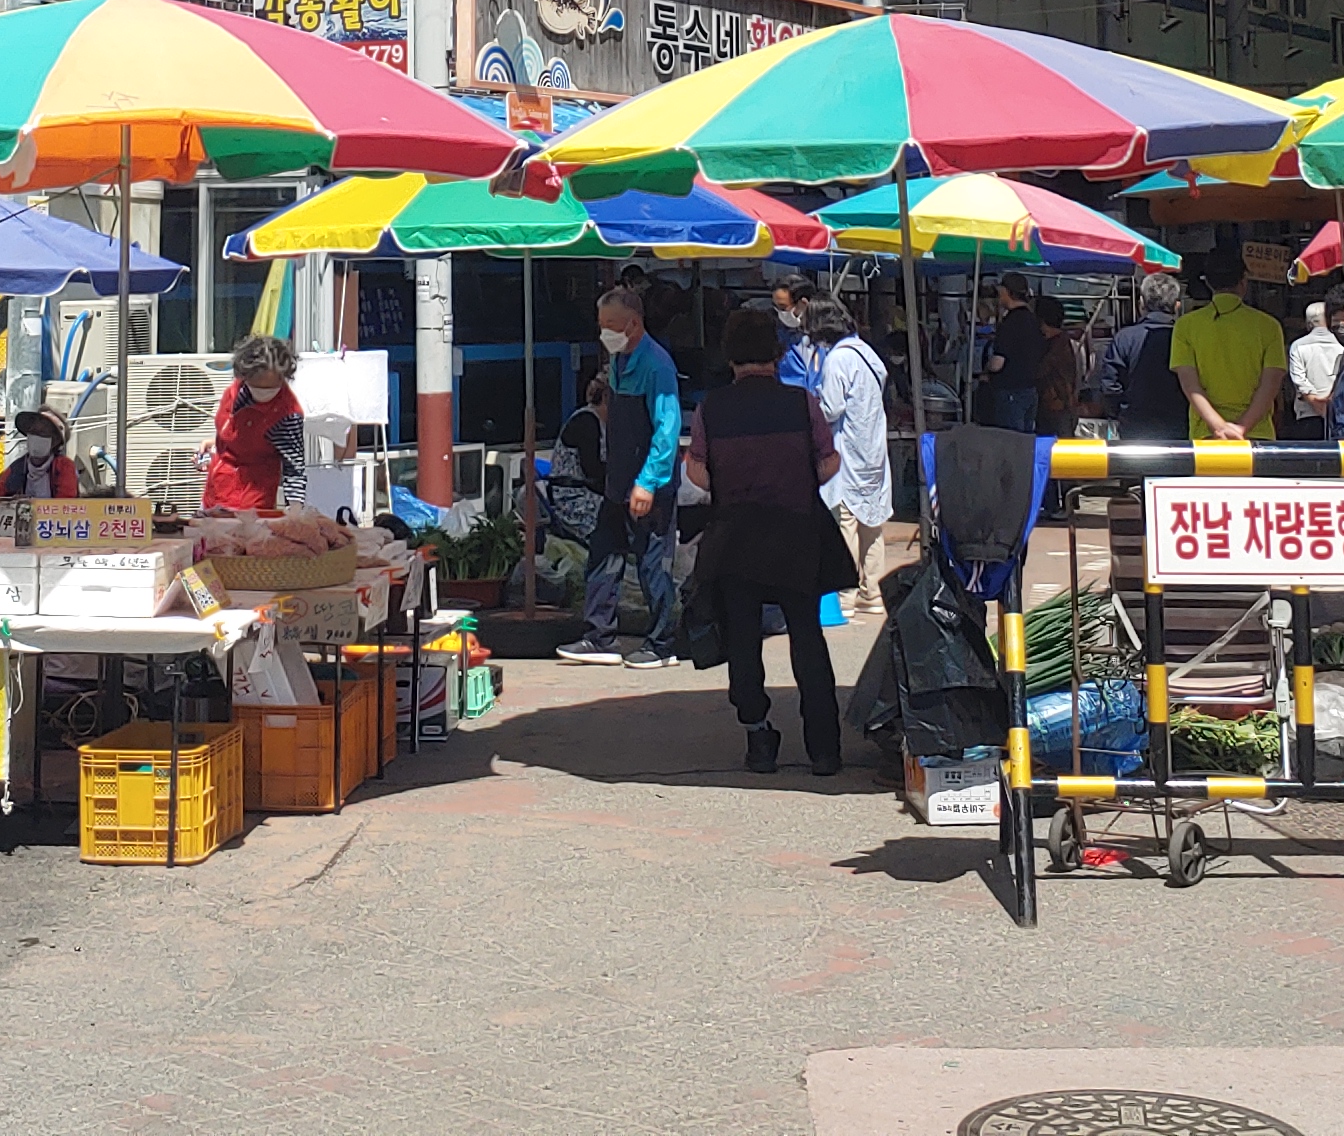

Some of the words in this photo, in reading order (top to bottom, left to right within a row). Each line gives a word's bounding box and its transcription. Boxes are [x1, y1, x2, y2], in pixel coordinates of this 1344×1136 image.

[36, 519, 91, 541] 장뇌삼
[99, 519, 147, 540] 2천원
[1170, 501, 1232, 560] 장날
